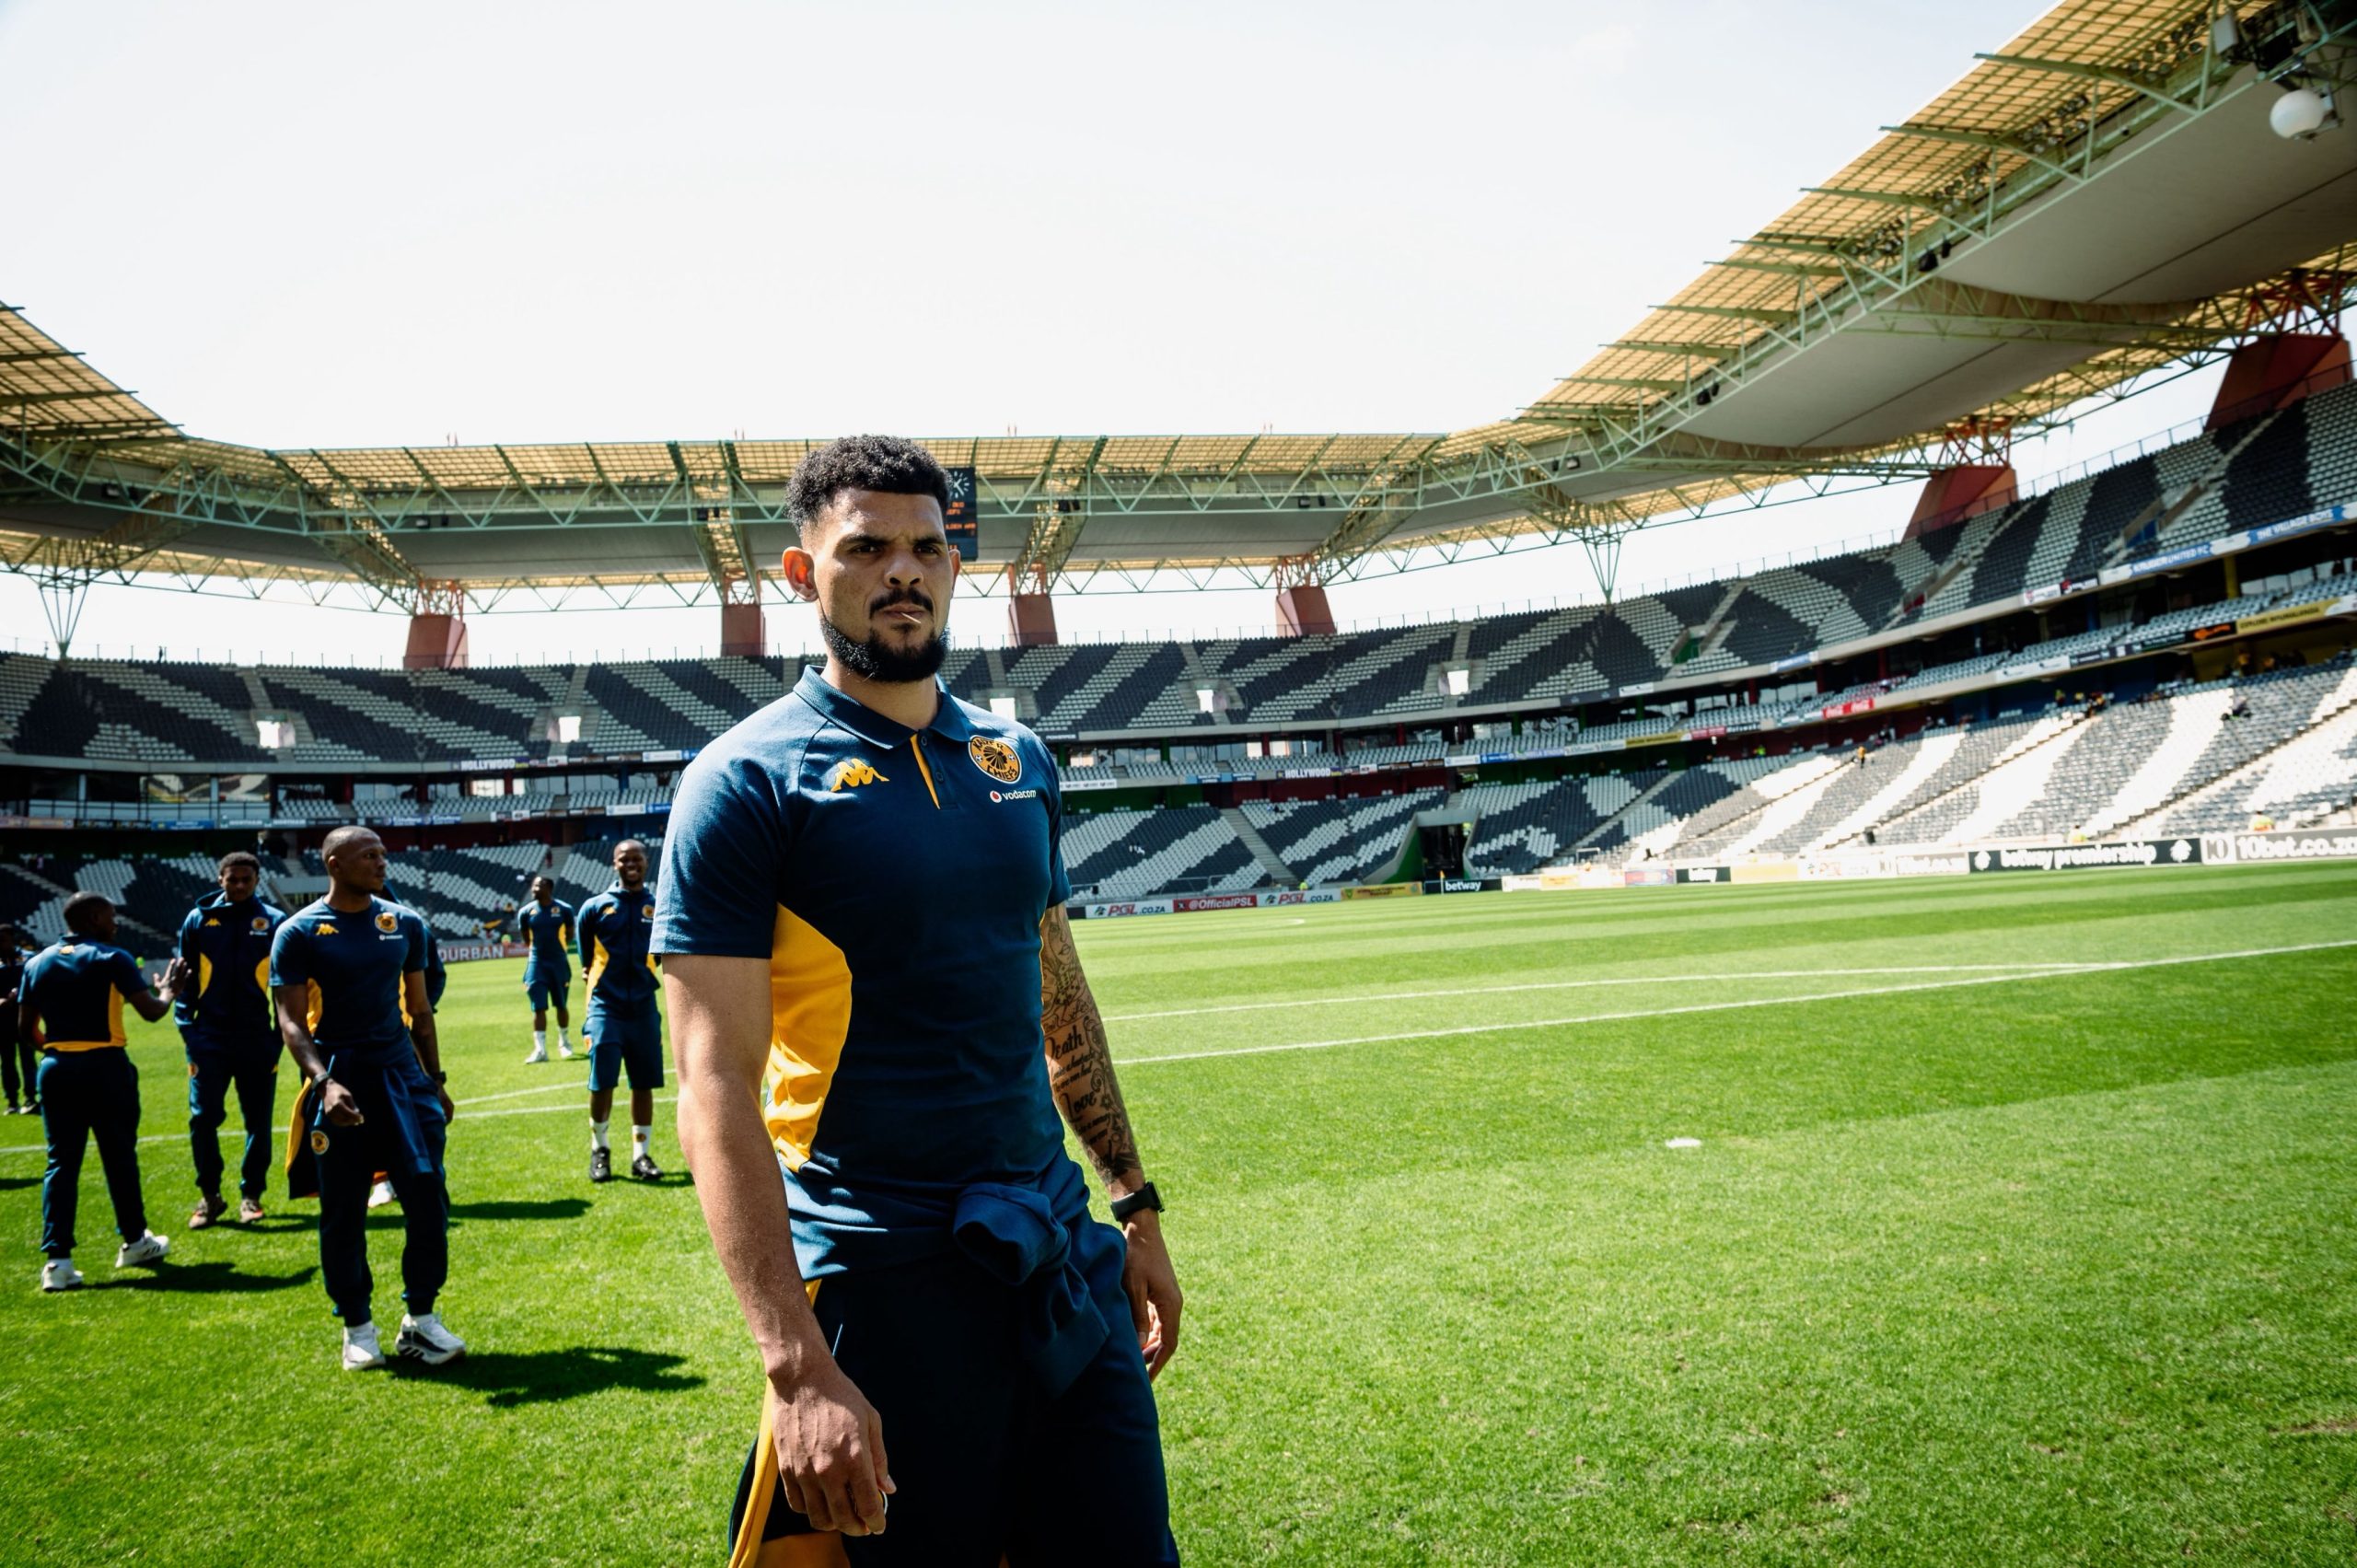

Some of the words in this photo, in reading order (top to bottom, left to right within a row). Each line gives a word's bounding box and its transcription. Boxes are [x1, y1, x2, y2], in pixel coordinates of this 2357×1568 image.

[461, 759, 516, 772] HOLLYWOOD
[987, 764, 1017, 781] CHIEFS
[1284, 767, 1331, 779] HOLLYWOOD
[1002, 789, 1037, 801] vodacom
[2054, 842, 2157, 870] premiership
[1446, 879, 1482, 892] betway
[1189, 894, 1254, 911] @OfficialPSL
[1059, 1091, 1098, 1123] Love
